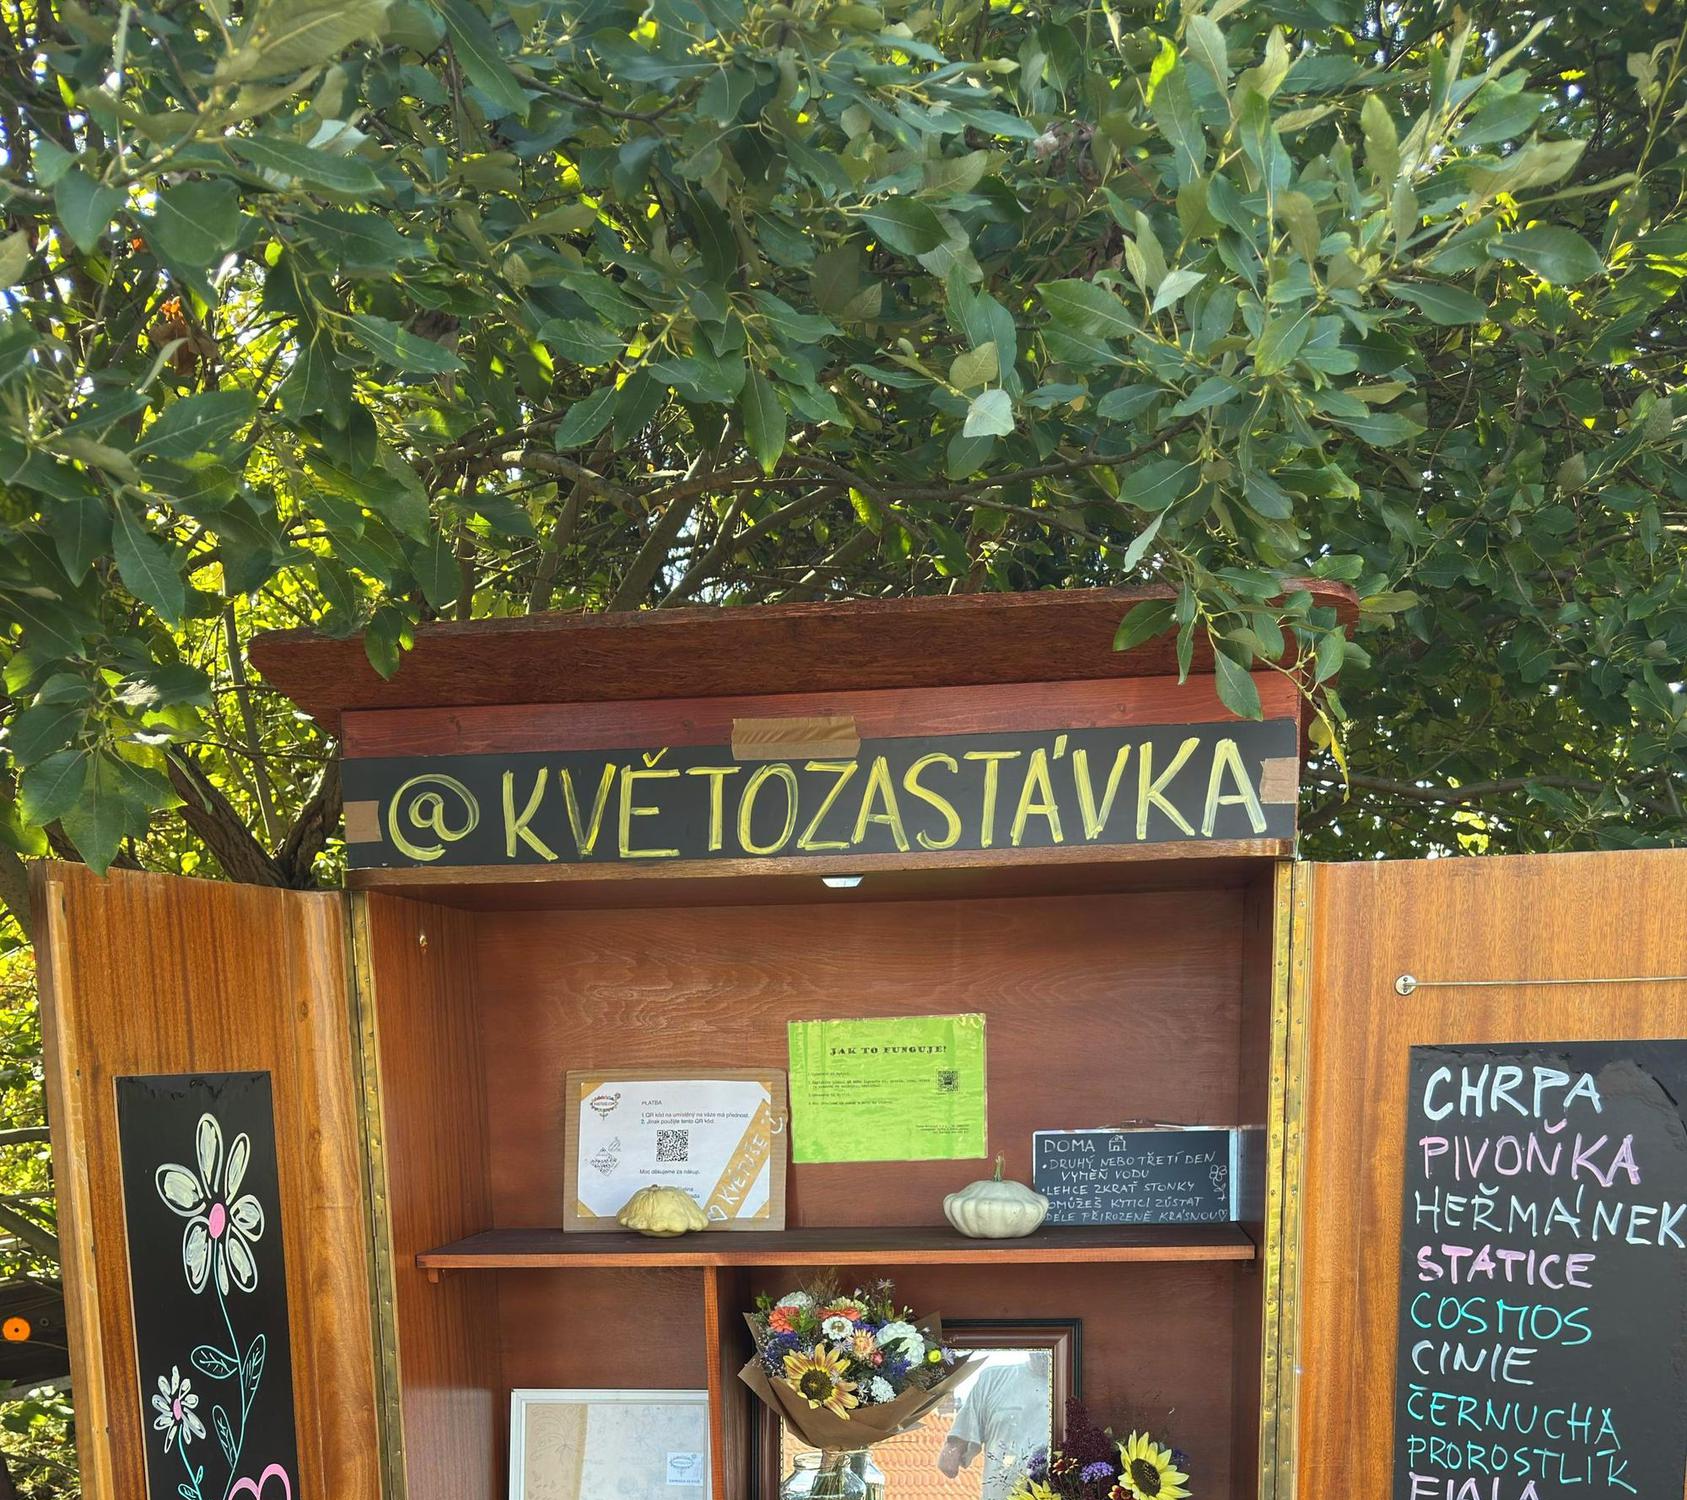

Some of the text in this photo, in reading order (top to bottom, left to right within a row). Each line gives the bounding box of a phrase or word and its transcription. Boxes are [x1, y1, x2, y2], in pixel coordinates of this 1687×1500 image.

[829, 1047, 856, 1056] JAK
[860, 1046, 879, 1054] TO
[1423, 1064, 1602, 1121] CHRPA
[1044, 1139, 1096, 1153] DOMA
[1049, 1151, 1216, 1170] DRUHÝ NEBO TŘETÍ DEN
[1419, 1118, 1641, 1187] PIVOŇKA
[1046, 1185, 1088, 1196] LEHCE
[1143, 1181, 1195, 1192] STONKY
[1061, 1168, 1149, 1183] VYMĚŇ VODU
[1045, 1196, 1102, 1209] OMŮŽEŠ
[1081, 1209, 1153, 1222] PŘIROZENĚ
[1160, 1208, 1218, 1222] KRÁSNOU
[1415, 1182, 1687, 1249] HEŘMÁNEK
[1416, 1244, 1595, 1290] STATICE
[1411, 1292, 1592, 1345] COSMOS
[1411, 1340, 1538, 1385] CINIE
[1407, 1383, 1621, 1450] ČERNUCHA
[1407, 1434, 1637, 1493] PROROSTLÍK
